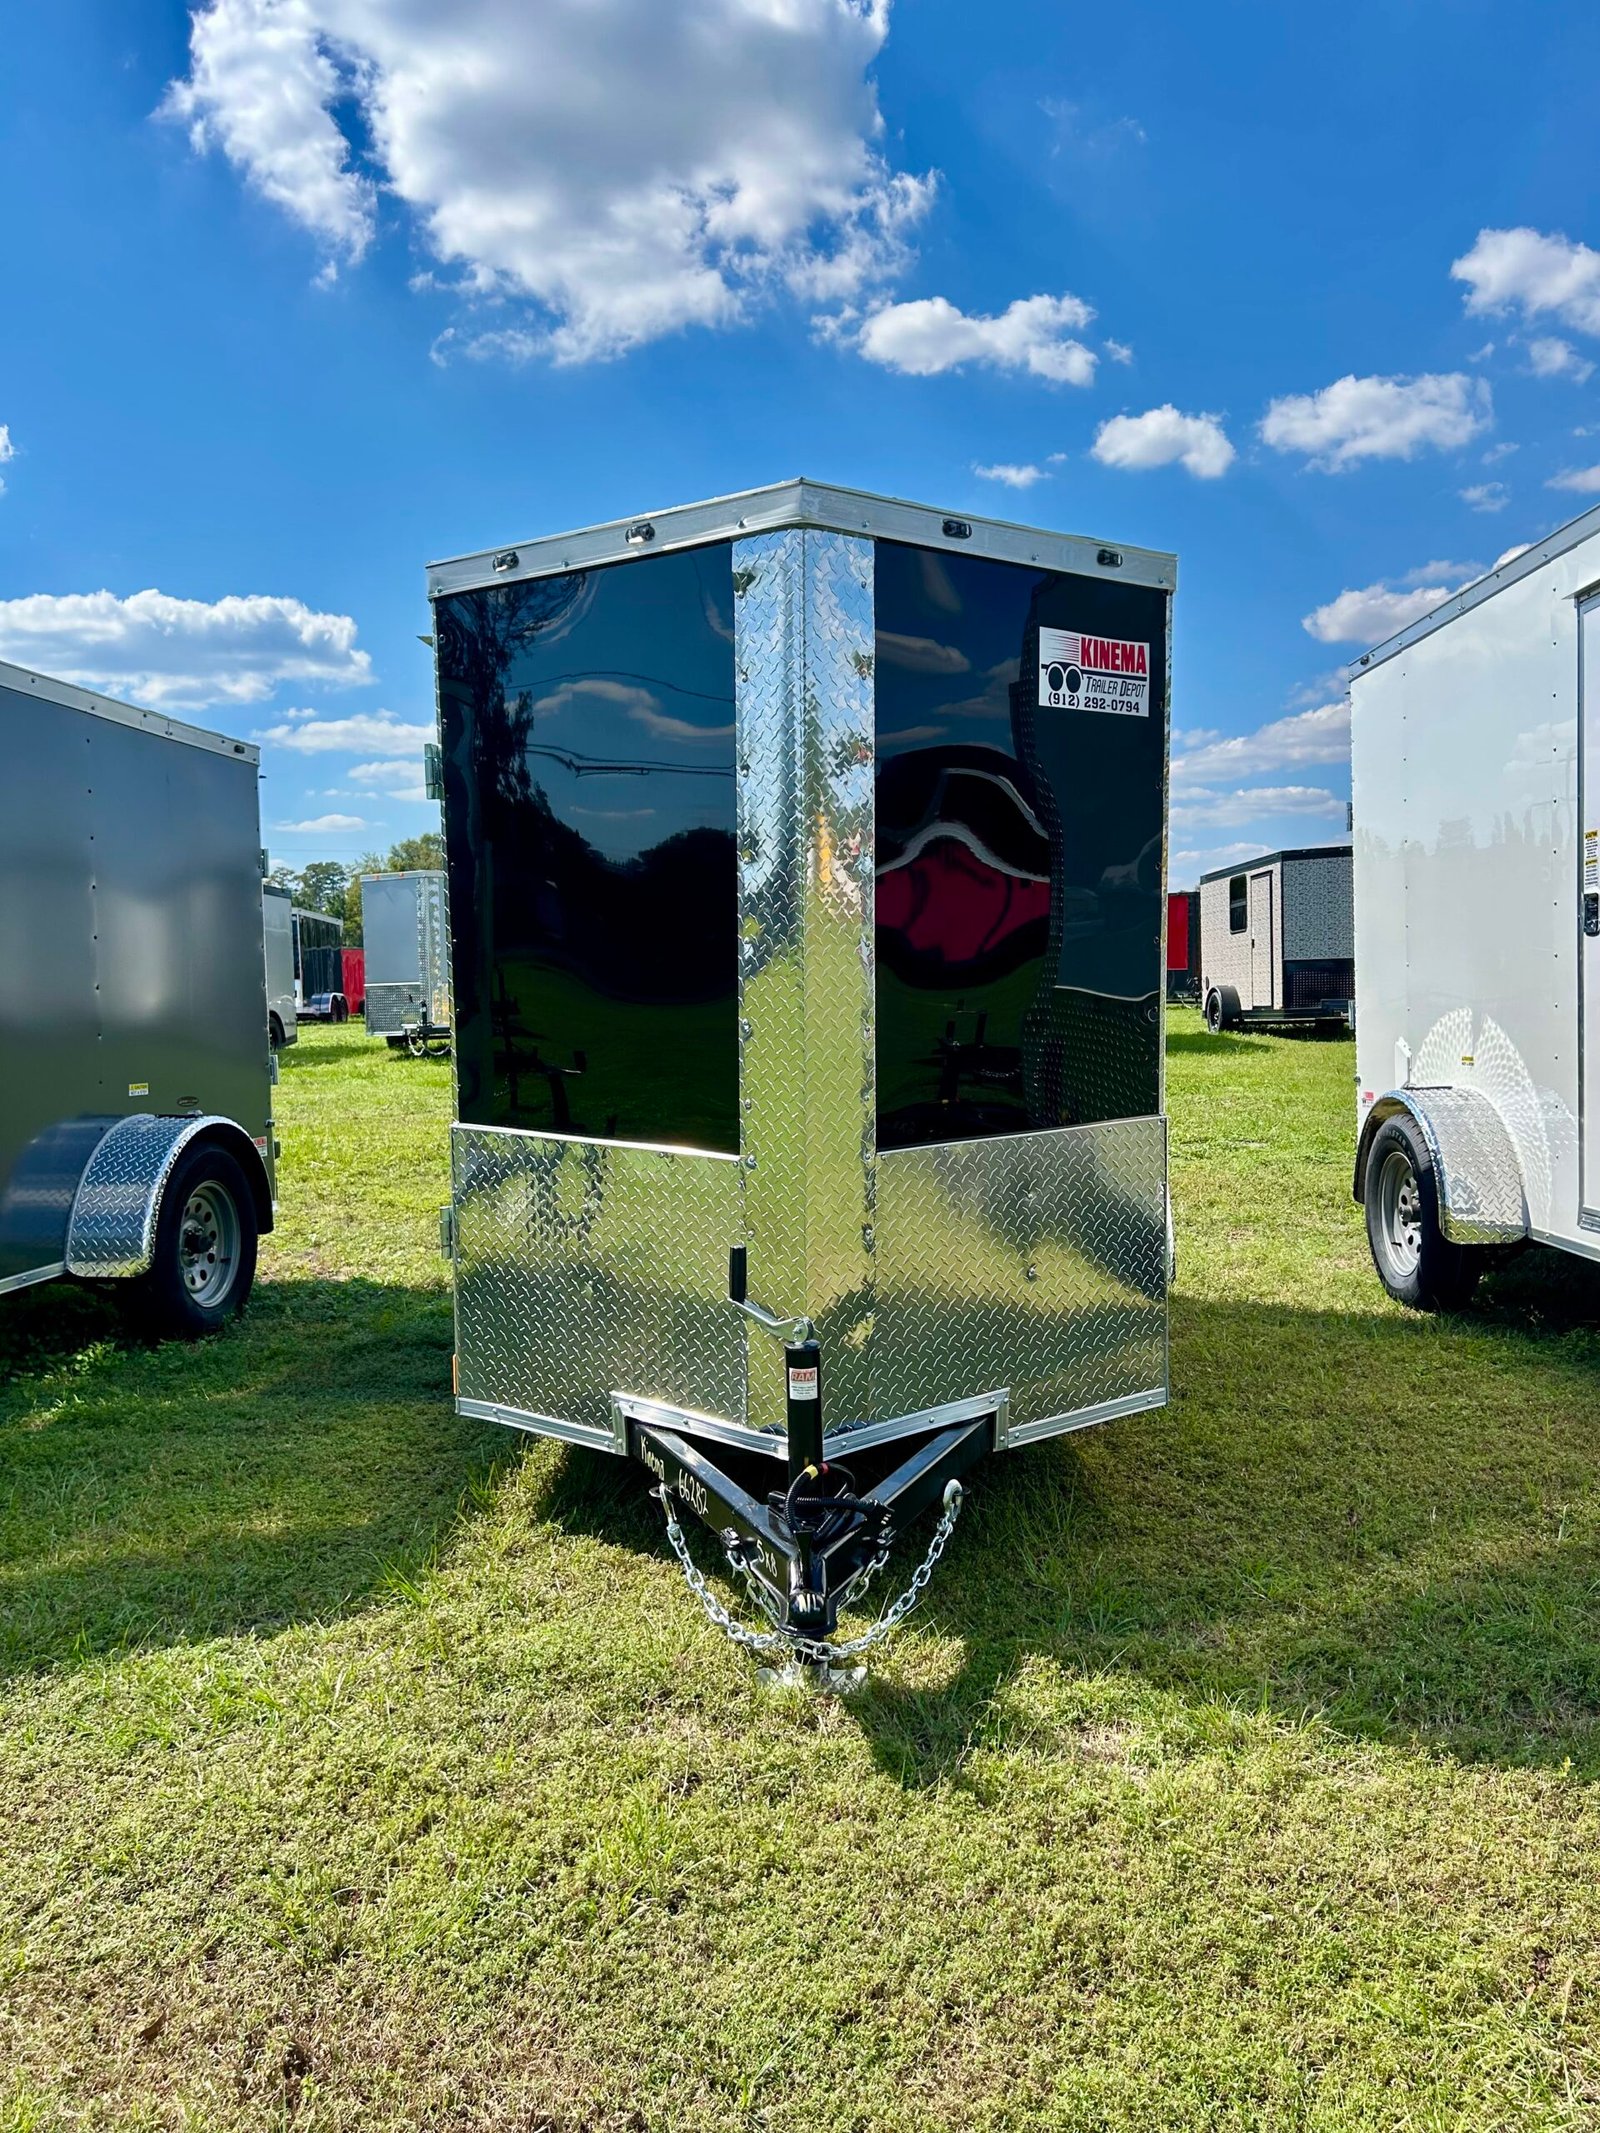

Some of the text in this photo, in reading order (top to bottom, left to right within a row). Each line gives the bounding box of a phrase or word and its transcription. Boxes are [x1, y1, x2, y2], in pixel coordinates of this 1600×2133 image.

[1080, 636, 1147, 674] KINEMA
[1085, 676, 1146, 698] TRAILER DEPOT
[1048, 692, 1140, 713] (912) 292-0794
[791, 1371, 815, 1381] RAM
[678, 1468, 709, 1515] 66282
